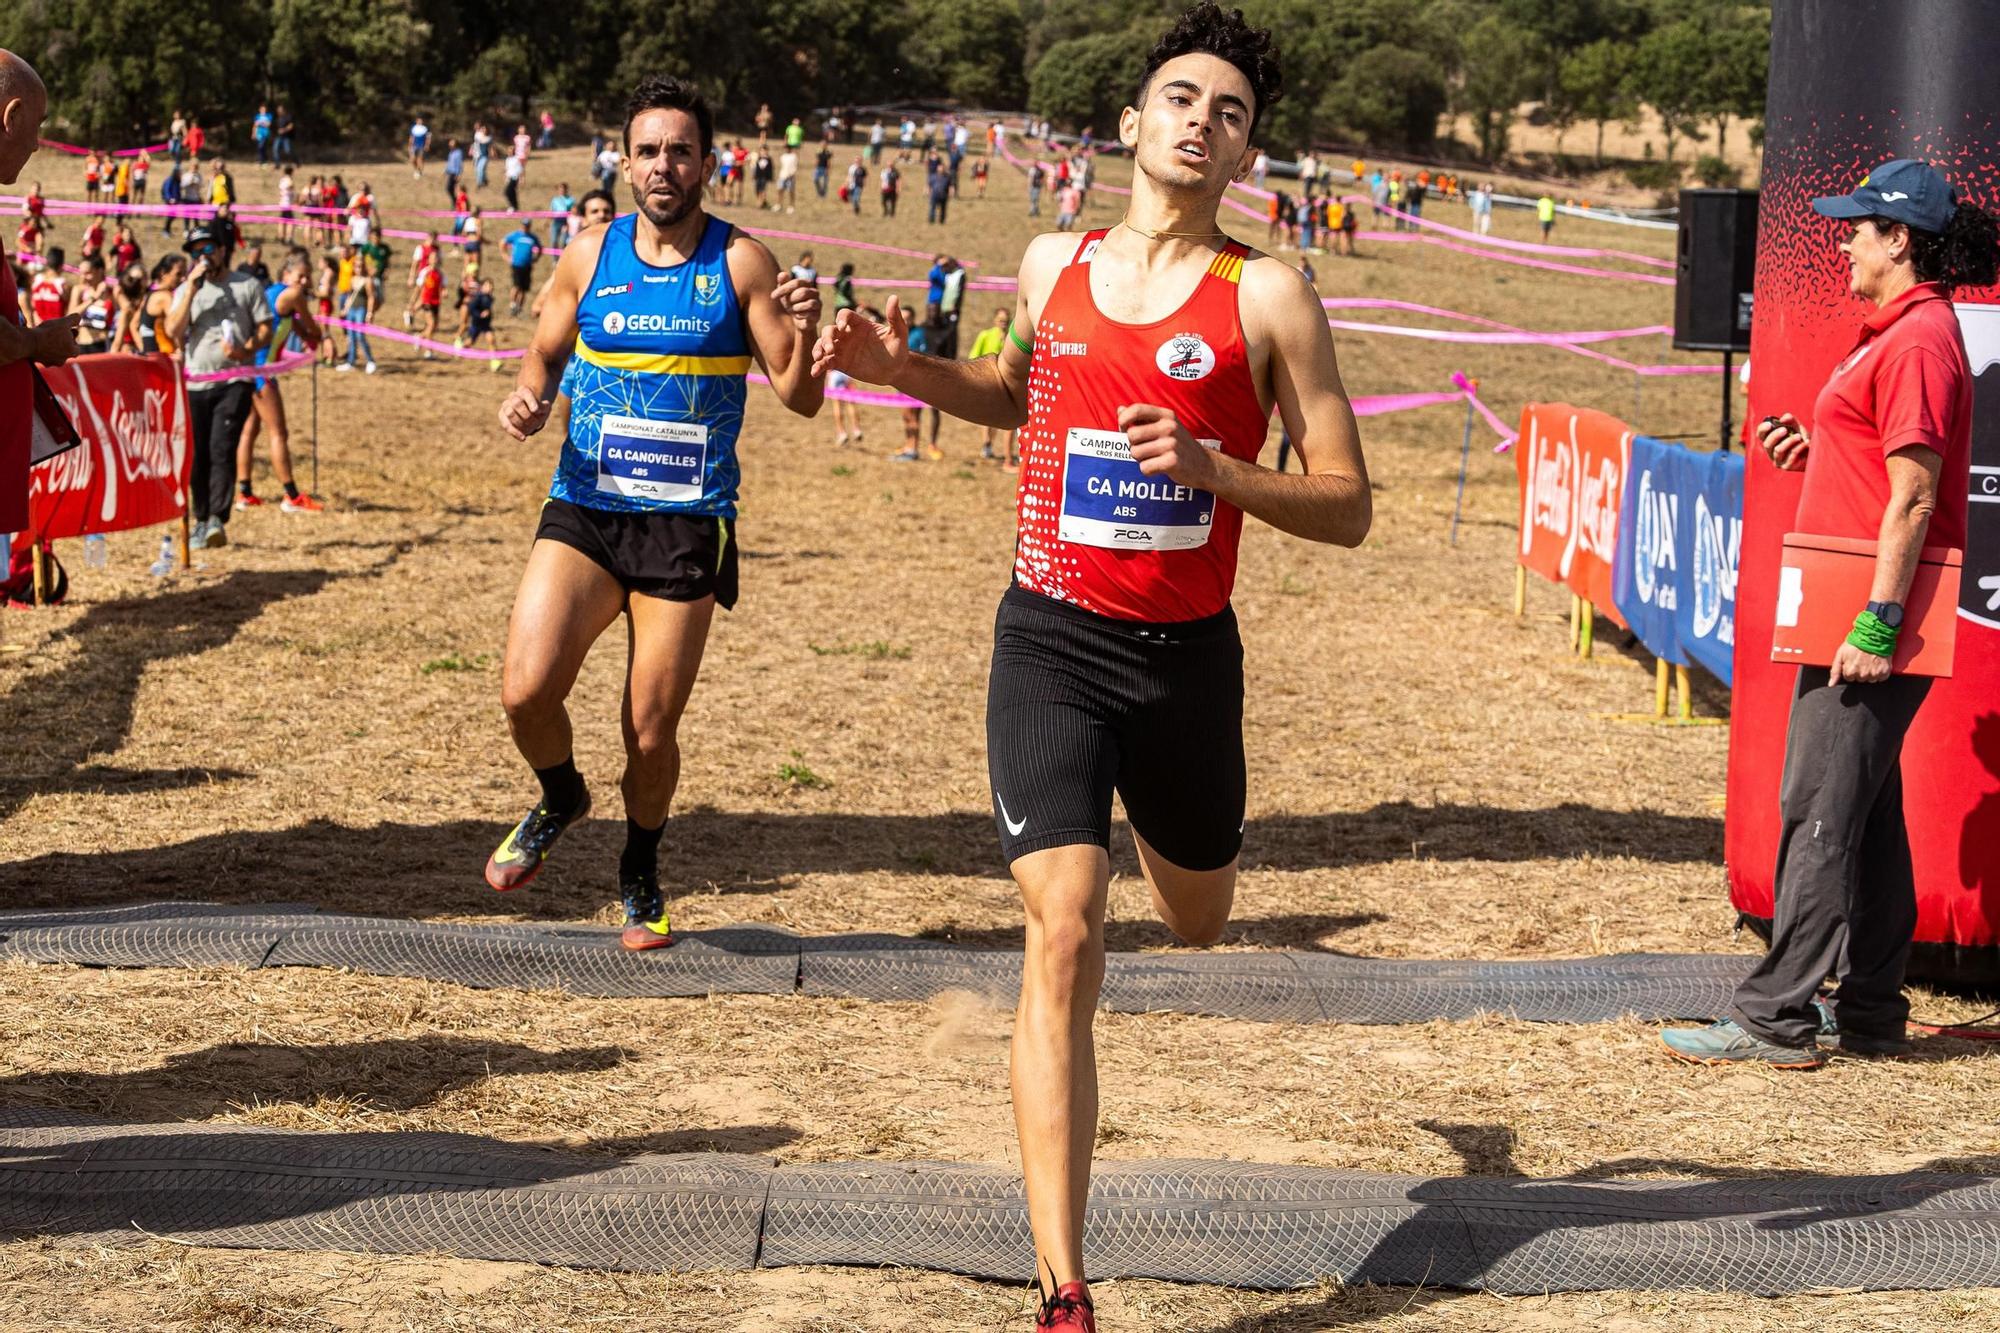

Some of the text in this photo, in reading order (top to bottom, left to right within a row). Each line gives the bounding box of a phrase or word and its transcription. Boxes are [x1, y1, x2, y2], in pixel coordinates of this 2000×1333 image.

[656, 427, 698, 437] CATALUNYA
[1080, 437, 1131, 452] CAMPION
[607, 447, 697, 467] CA CANOVELLES
[1096, 449, 1133, 460] CROS RELLE
[631, 467, 649, 476] ABS
[1087, 476, 1194, 502] CA MOLLET
[1113, 506, 1137, 517] ABS
[1113, 529, 1153, 541] FCA
